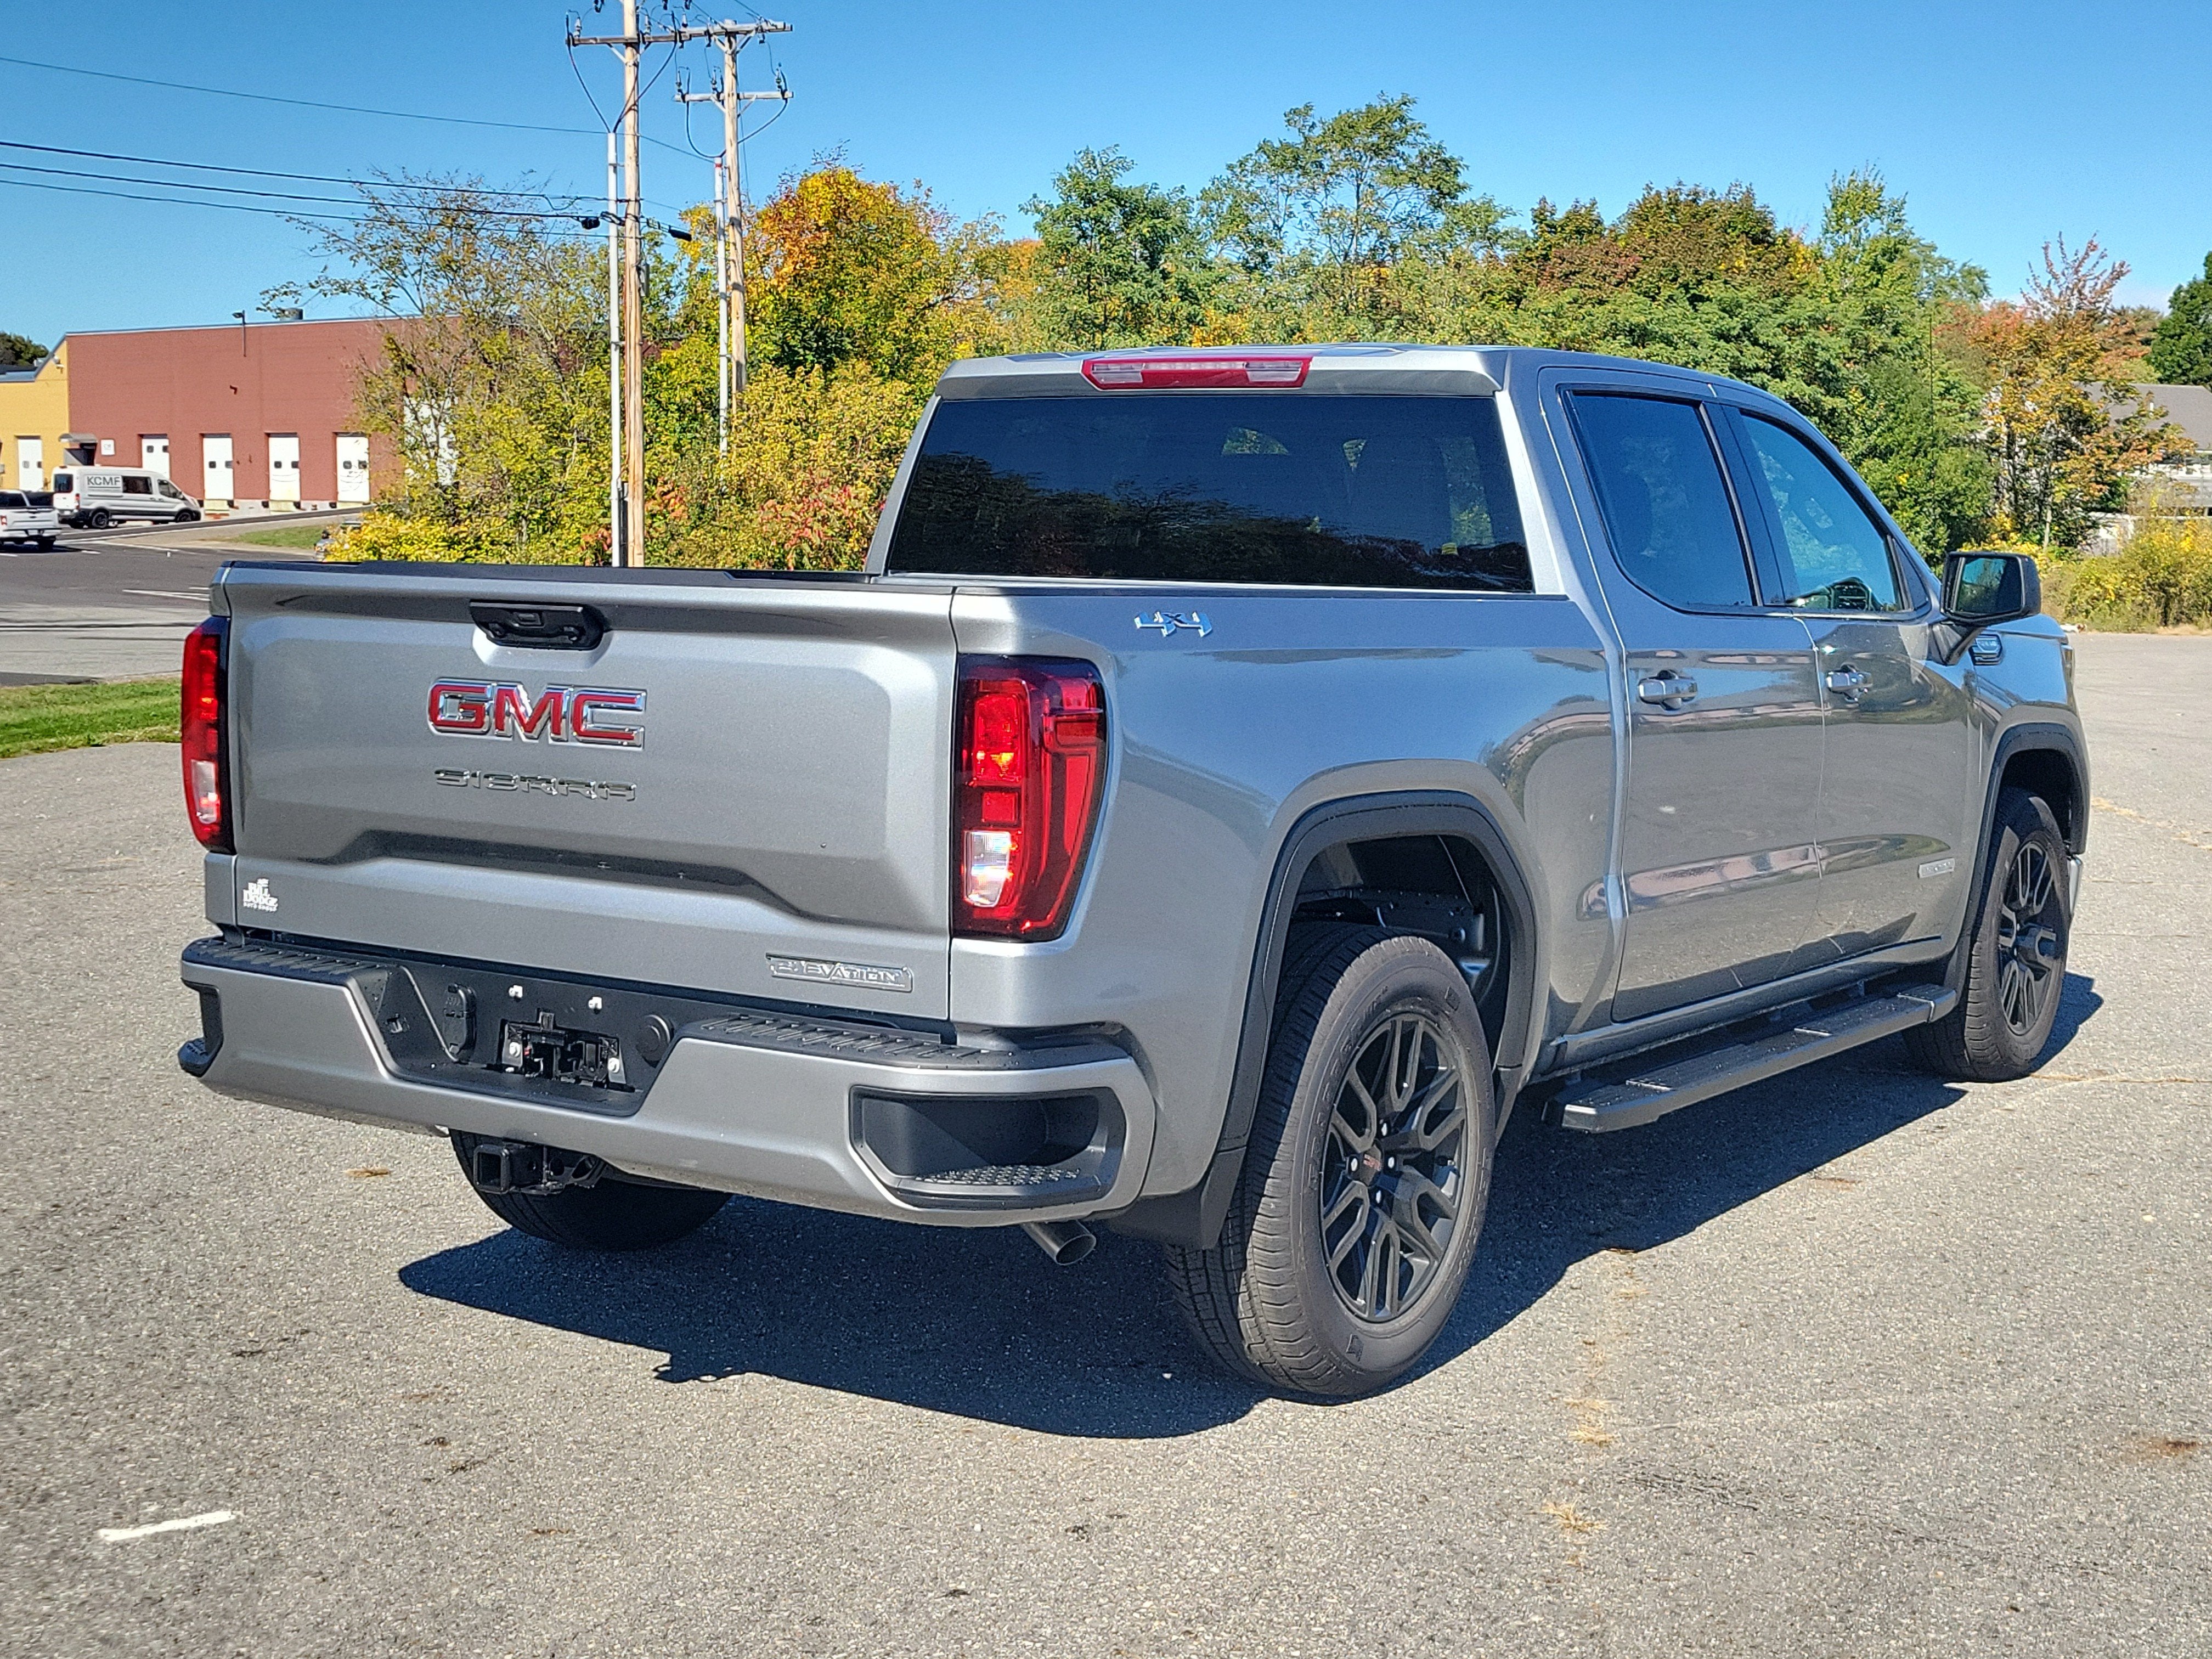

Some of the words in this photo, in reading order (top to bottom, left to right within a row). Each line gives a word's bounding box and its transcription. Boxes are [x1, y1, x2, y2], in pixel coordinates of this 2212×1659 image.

[87, 476, 120, 486] KCMF
[428, 676, 647, 748] GMC
[434, 769, 636, 802] SIERRA
